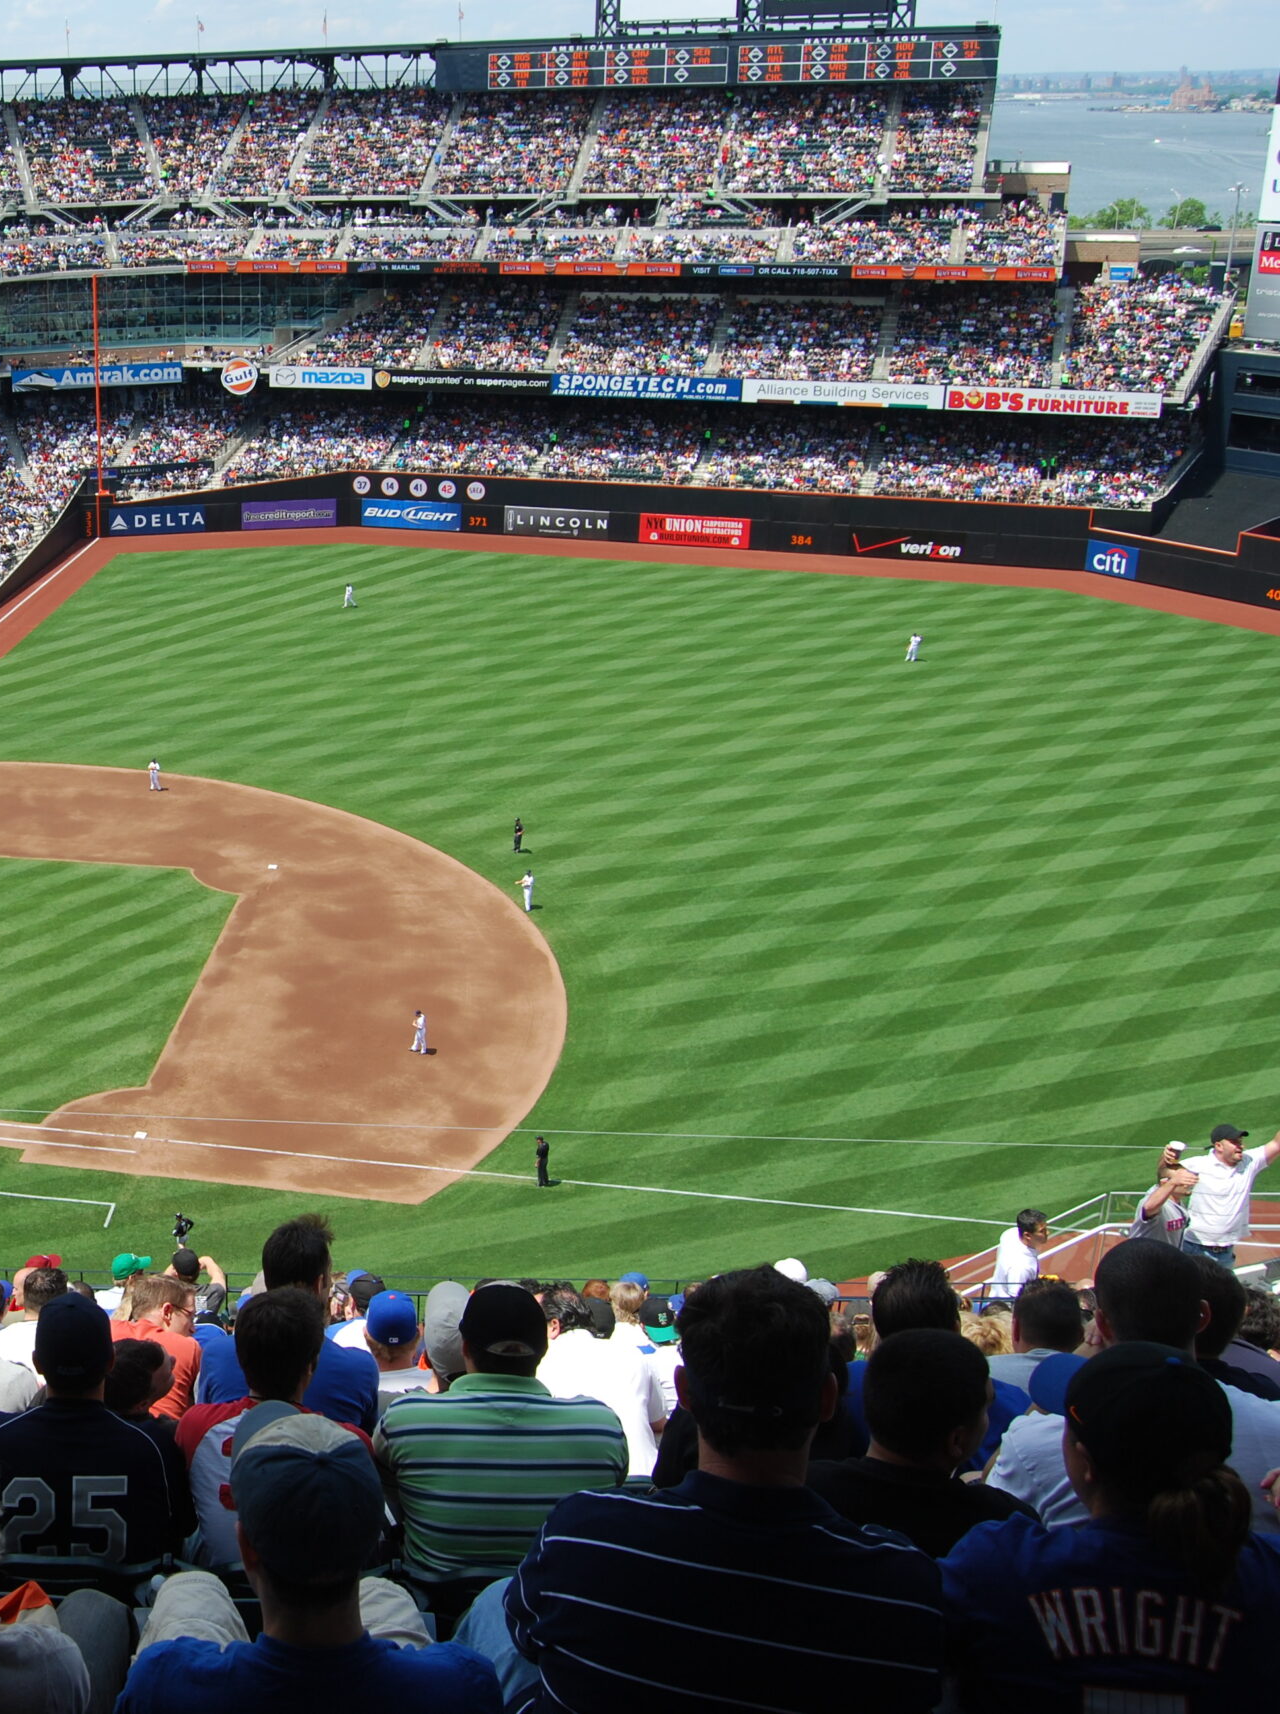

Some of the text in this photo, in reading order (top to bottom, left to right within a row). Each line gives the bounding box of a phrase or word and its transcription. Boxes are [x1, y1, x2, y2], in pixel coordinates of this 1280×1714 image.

[804, 35, 927, 45] NATIONAL LEAGUE
[963, 40, 980, 49] STL
[896, 52, 912, 60] PIT
[771, 267, 791, 275] CALL
[60, 366, 182, 386] Amtrak.com
[224, 368, 254, 385] Gulf
[302, 370, 365, 385] mazda
[475, 378, 549, 388] superpages.com
[558, 374, 727, 394] SPONGETECH.com
[757, 383, 929, 400] Alliance Building Services
[552, 388, 597, 396] AMERICA'S
[598, 389, 637, 398] CLEANING
[948, 390, 1024, 411] BOB'S
[1044, 393, 1114, 401] DISCOUNT
[1027, 398, 1129, 415] FURNITURE
[356, 481, 368, 490] 37
[385, 482, 394, 492] 14
[413, 483, 424, 493] 41
[441, 484, 453, 494] 42
[134, 512, 205, 528] DELTA
[244, 508, 335, 523] freecreditreport.com
[363, 507, 459, 522] BUD LIGHT
[469, 517, 487, 527] 371
[517, 515, 608, 530] LINCOLN
[791, 535, 812, 545] 384
[900, 541, 961, 560] verizon
[1093, 551, 1127, 575] citi
[1, 1475, 128, 1562] 25
[1027, 1586, 1244, 1674] WRIGHT
